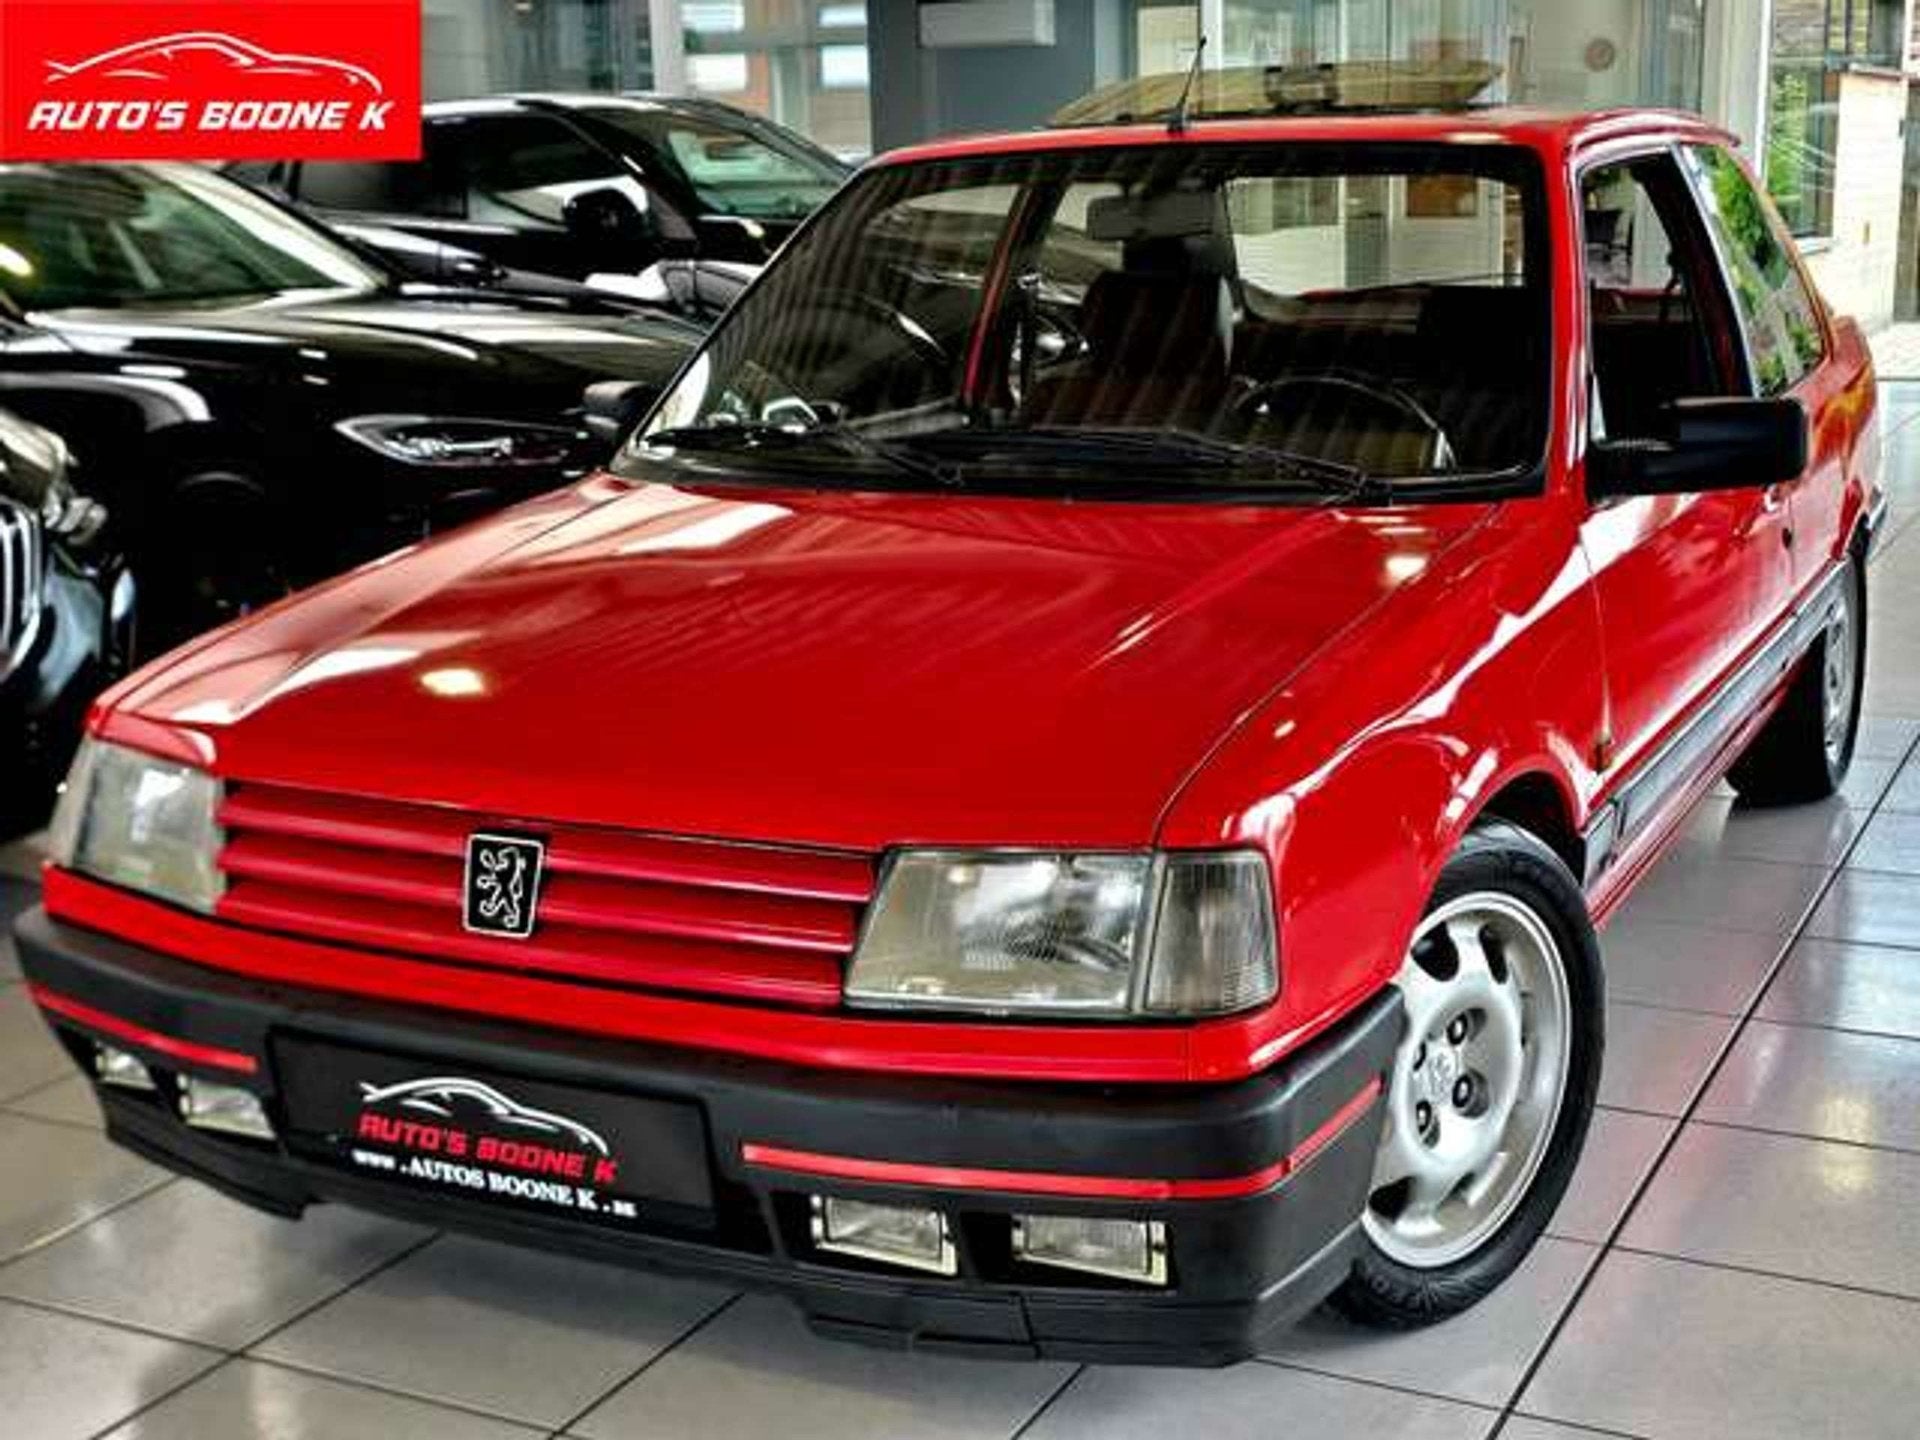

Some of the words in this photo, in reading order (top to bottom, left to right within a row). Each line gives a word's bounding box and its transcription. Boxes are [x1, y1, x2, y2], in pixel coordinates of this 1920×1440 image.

[359, 1112, 468, 1156] AUTO'S
[476, 1136, 587, 1178] BOONE
[594, 1156, 617, 1184] K
[488, 1175, 574, 1207] BOONE
[576, 1188, 598, 1212] K
